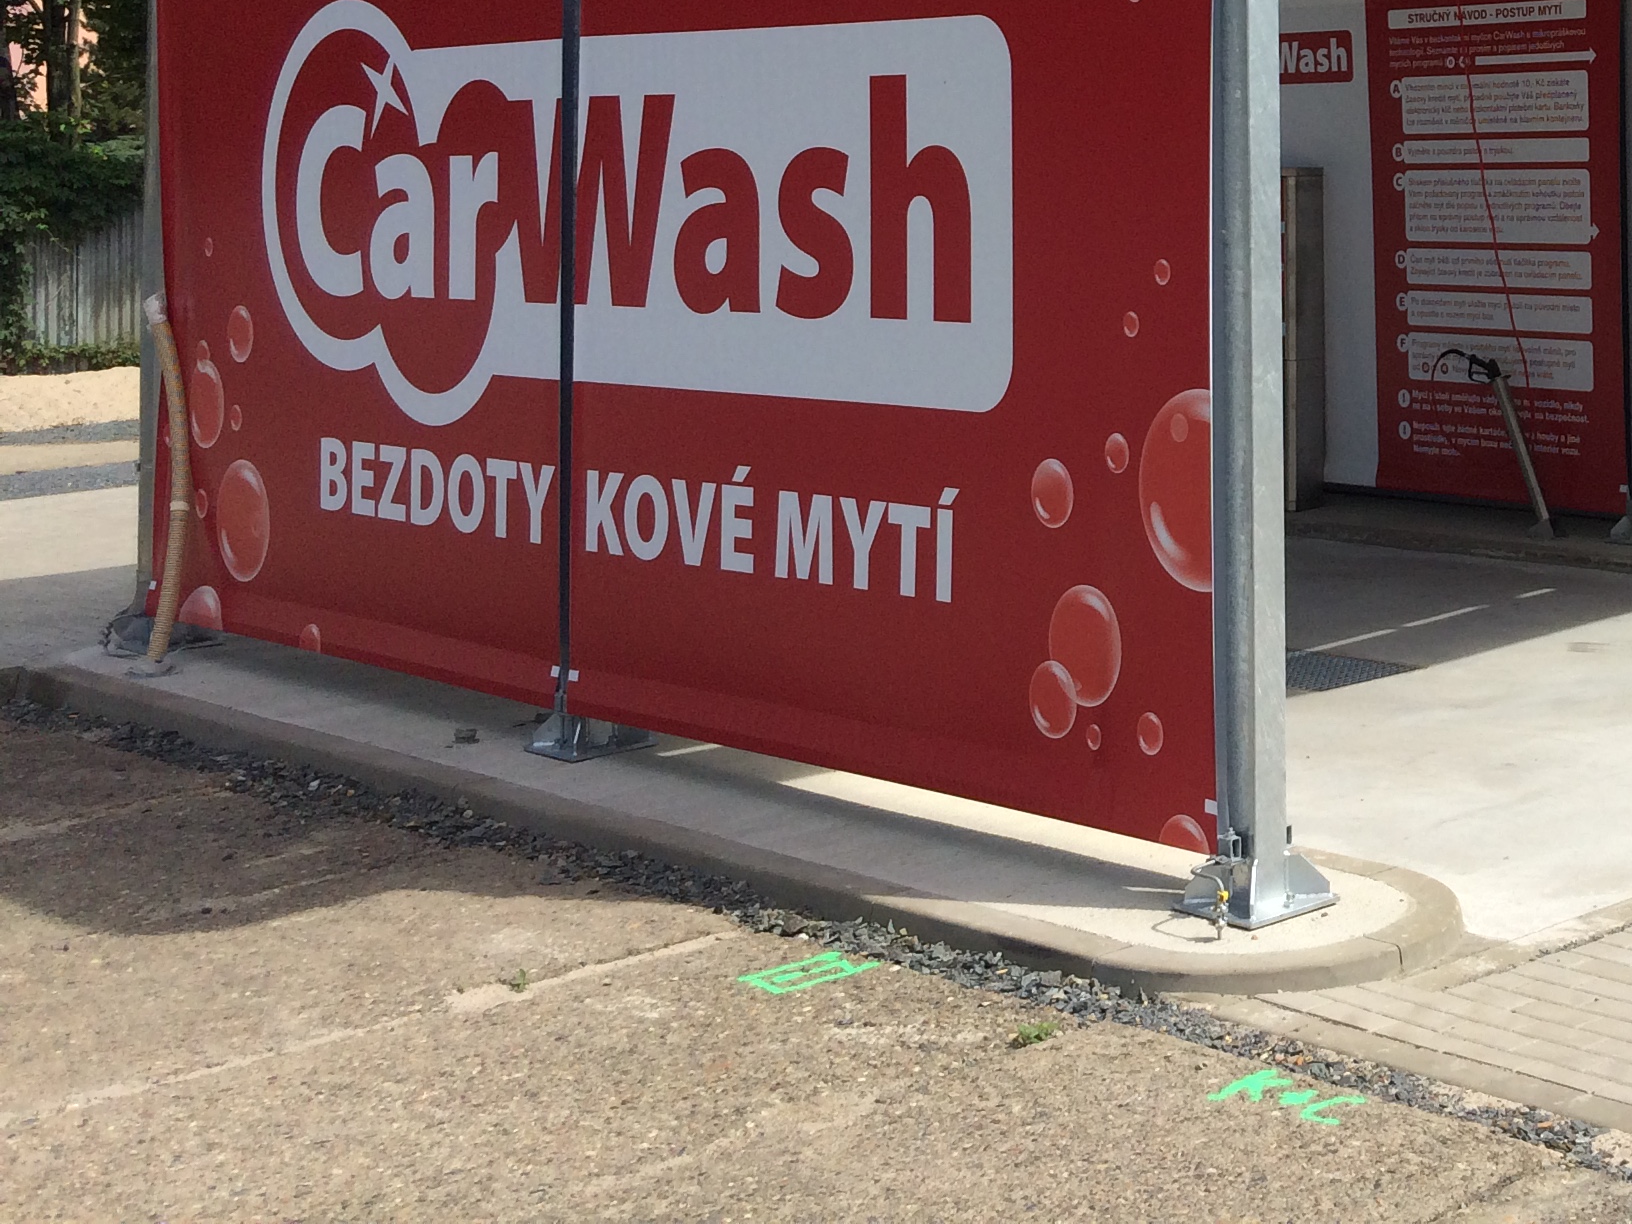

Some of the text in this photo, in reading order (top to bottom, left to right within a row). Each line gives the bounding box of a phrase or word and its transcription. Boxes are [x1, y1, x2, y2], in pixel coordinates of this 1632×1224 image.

[1496, 7, 1535, 19] POSTUP
[1538, 2, 1562, 16] MYTÍ
[292, 73, 974, 325] CarWash
[775, 487, 958, 604] MYTÍ
